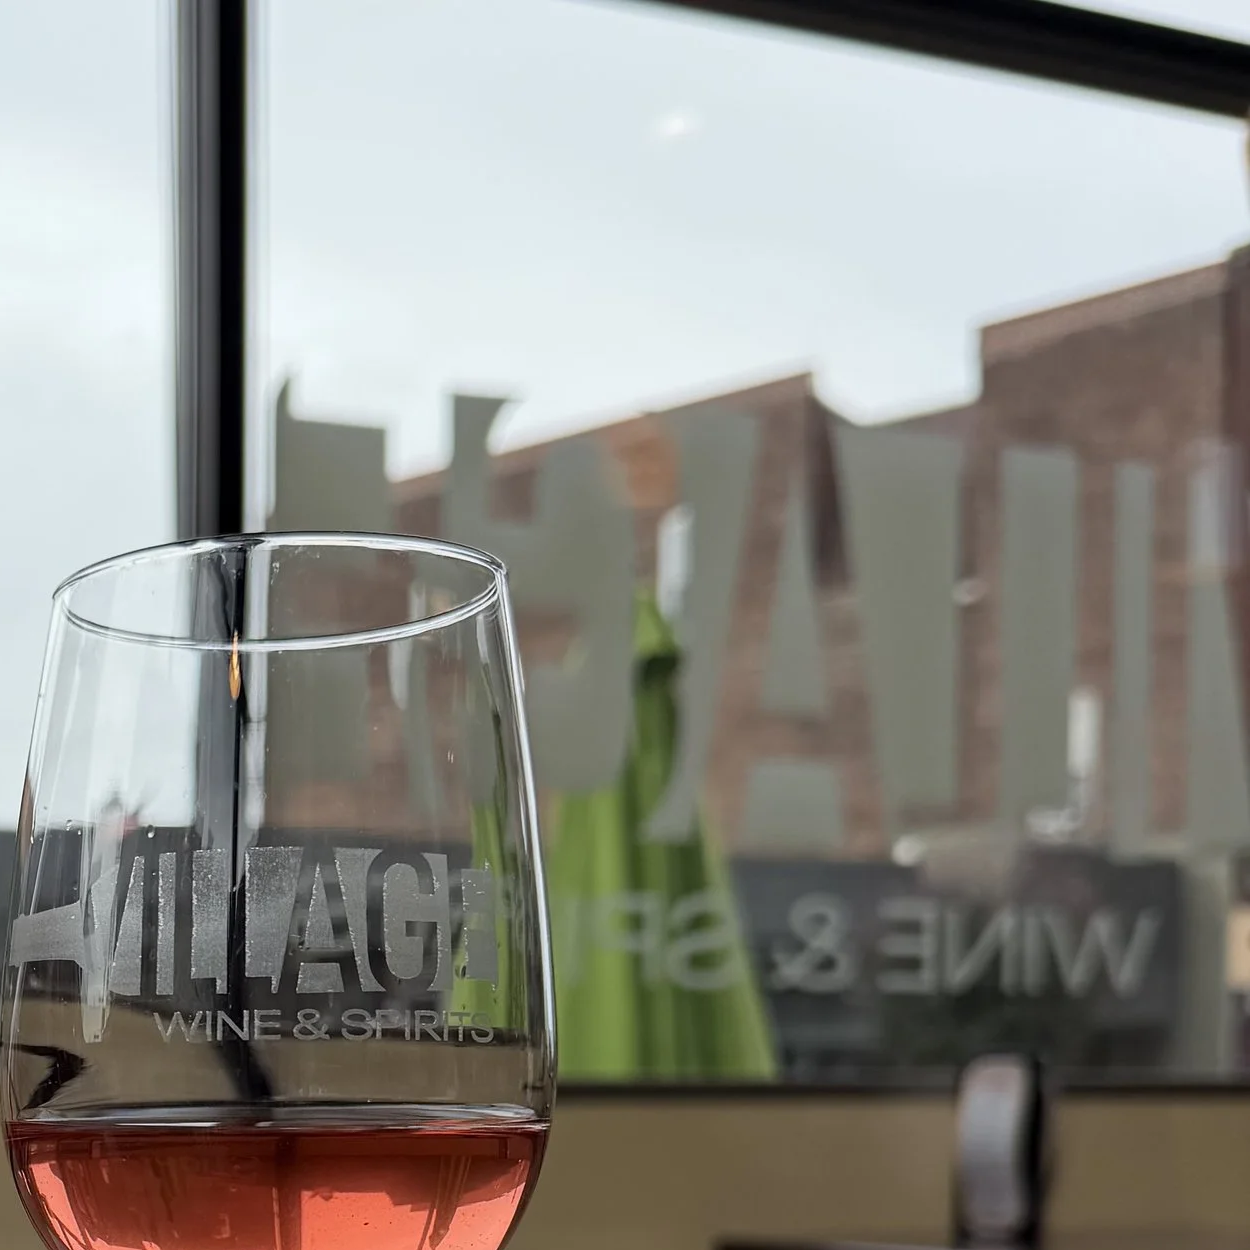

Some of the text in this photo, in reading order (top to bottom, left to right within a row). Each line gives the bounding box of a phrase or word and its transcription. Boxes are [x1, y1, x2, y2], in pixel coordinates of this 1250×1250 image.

[153, 1009, 495, 1042] WINE & SPIRITS
